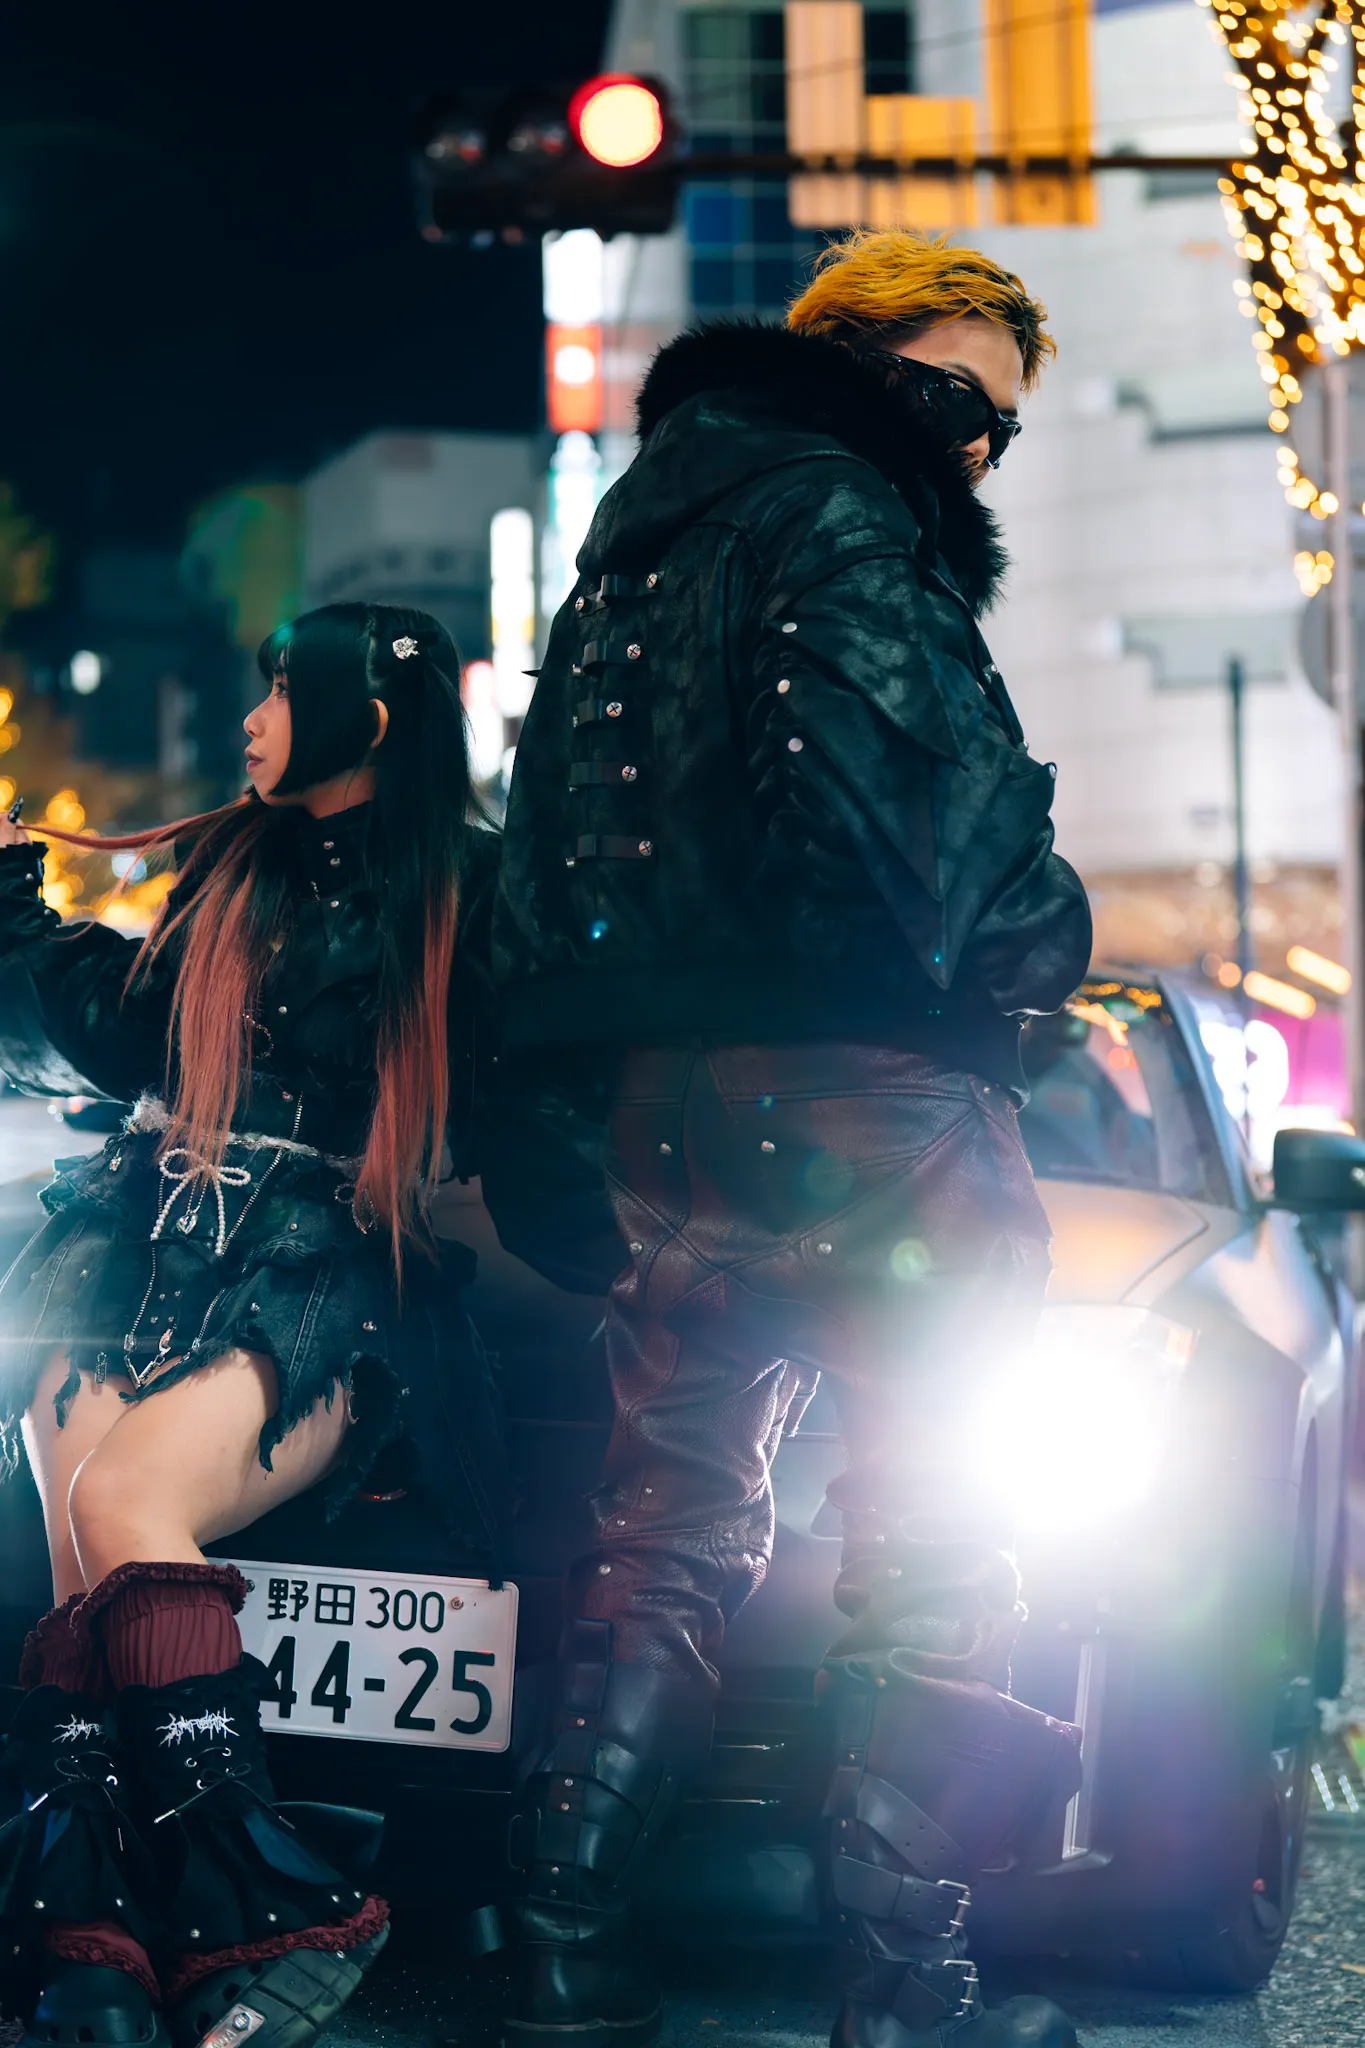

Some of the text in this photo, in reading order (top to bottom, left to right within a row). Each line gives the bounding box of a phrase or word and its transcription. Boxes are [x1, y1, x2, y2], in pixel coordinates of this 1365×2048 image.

[267, 1578, 445, 1633] 野田 300
[260, 1635, 495, 1735] 44-25
